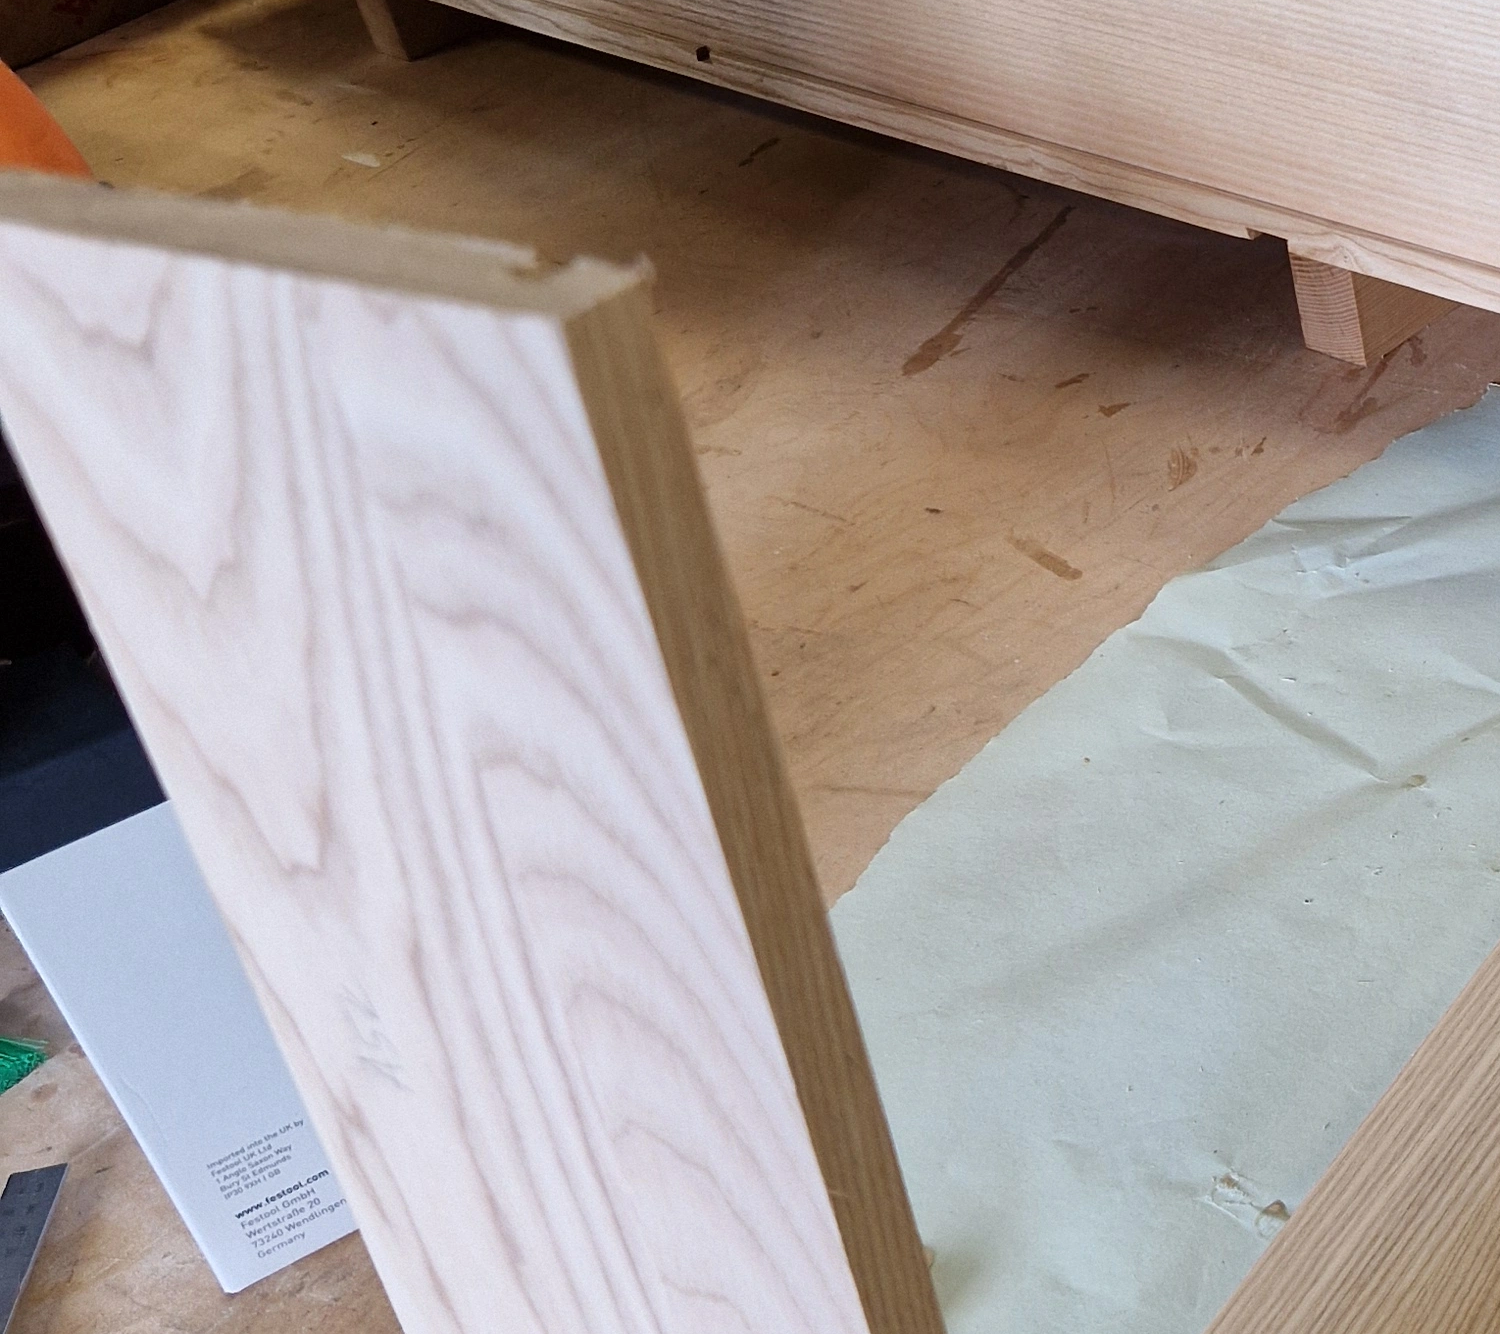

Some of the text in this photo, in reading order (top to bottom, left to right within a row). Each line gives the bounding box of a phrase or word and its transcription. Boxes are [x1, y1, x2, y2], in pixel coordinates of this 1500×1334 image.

[207, 1119, 304, 1169] Imported into the UK by
[211, 1143, 272, 1177] Festool UK Ltd
[223, 1167, 247, 1181] Anglo
[248, 1154, 274, 1168] Saxon
[274, 1144, 292, 1155] Way
[252, 1155, 292, 1177] Edmunds
[235, 1169, 329, 1219] www.festool.com
[241, 1188, 316, 1229] Festool GmbH
[246, 1198, 321, 1239] Wertstraße 20
[251, 1197, 347, 1248] 73240 Wendlingen
[257, 1232, 306, 1259] Germany
